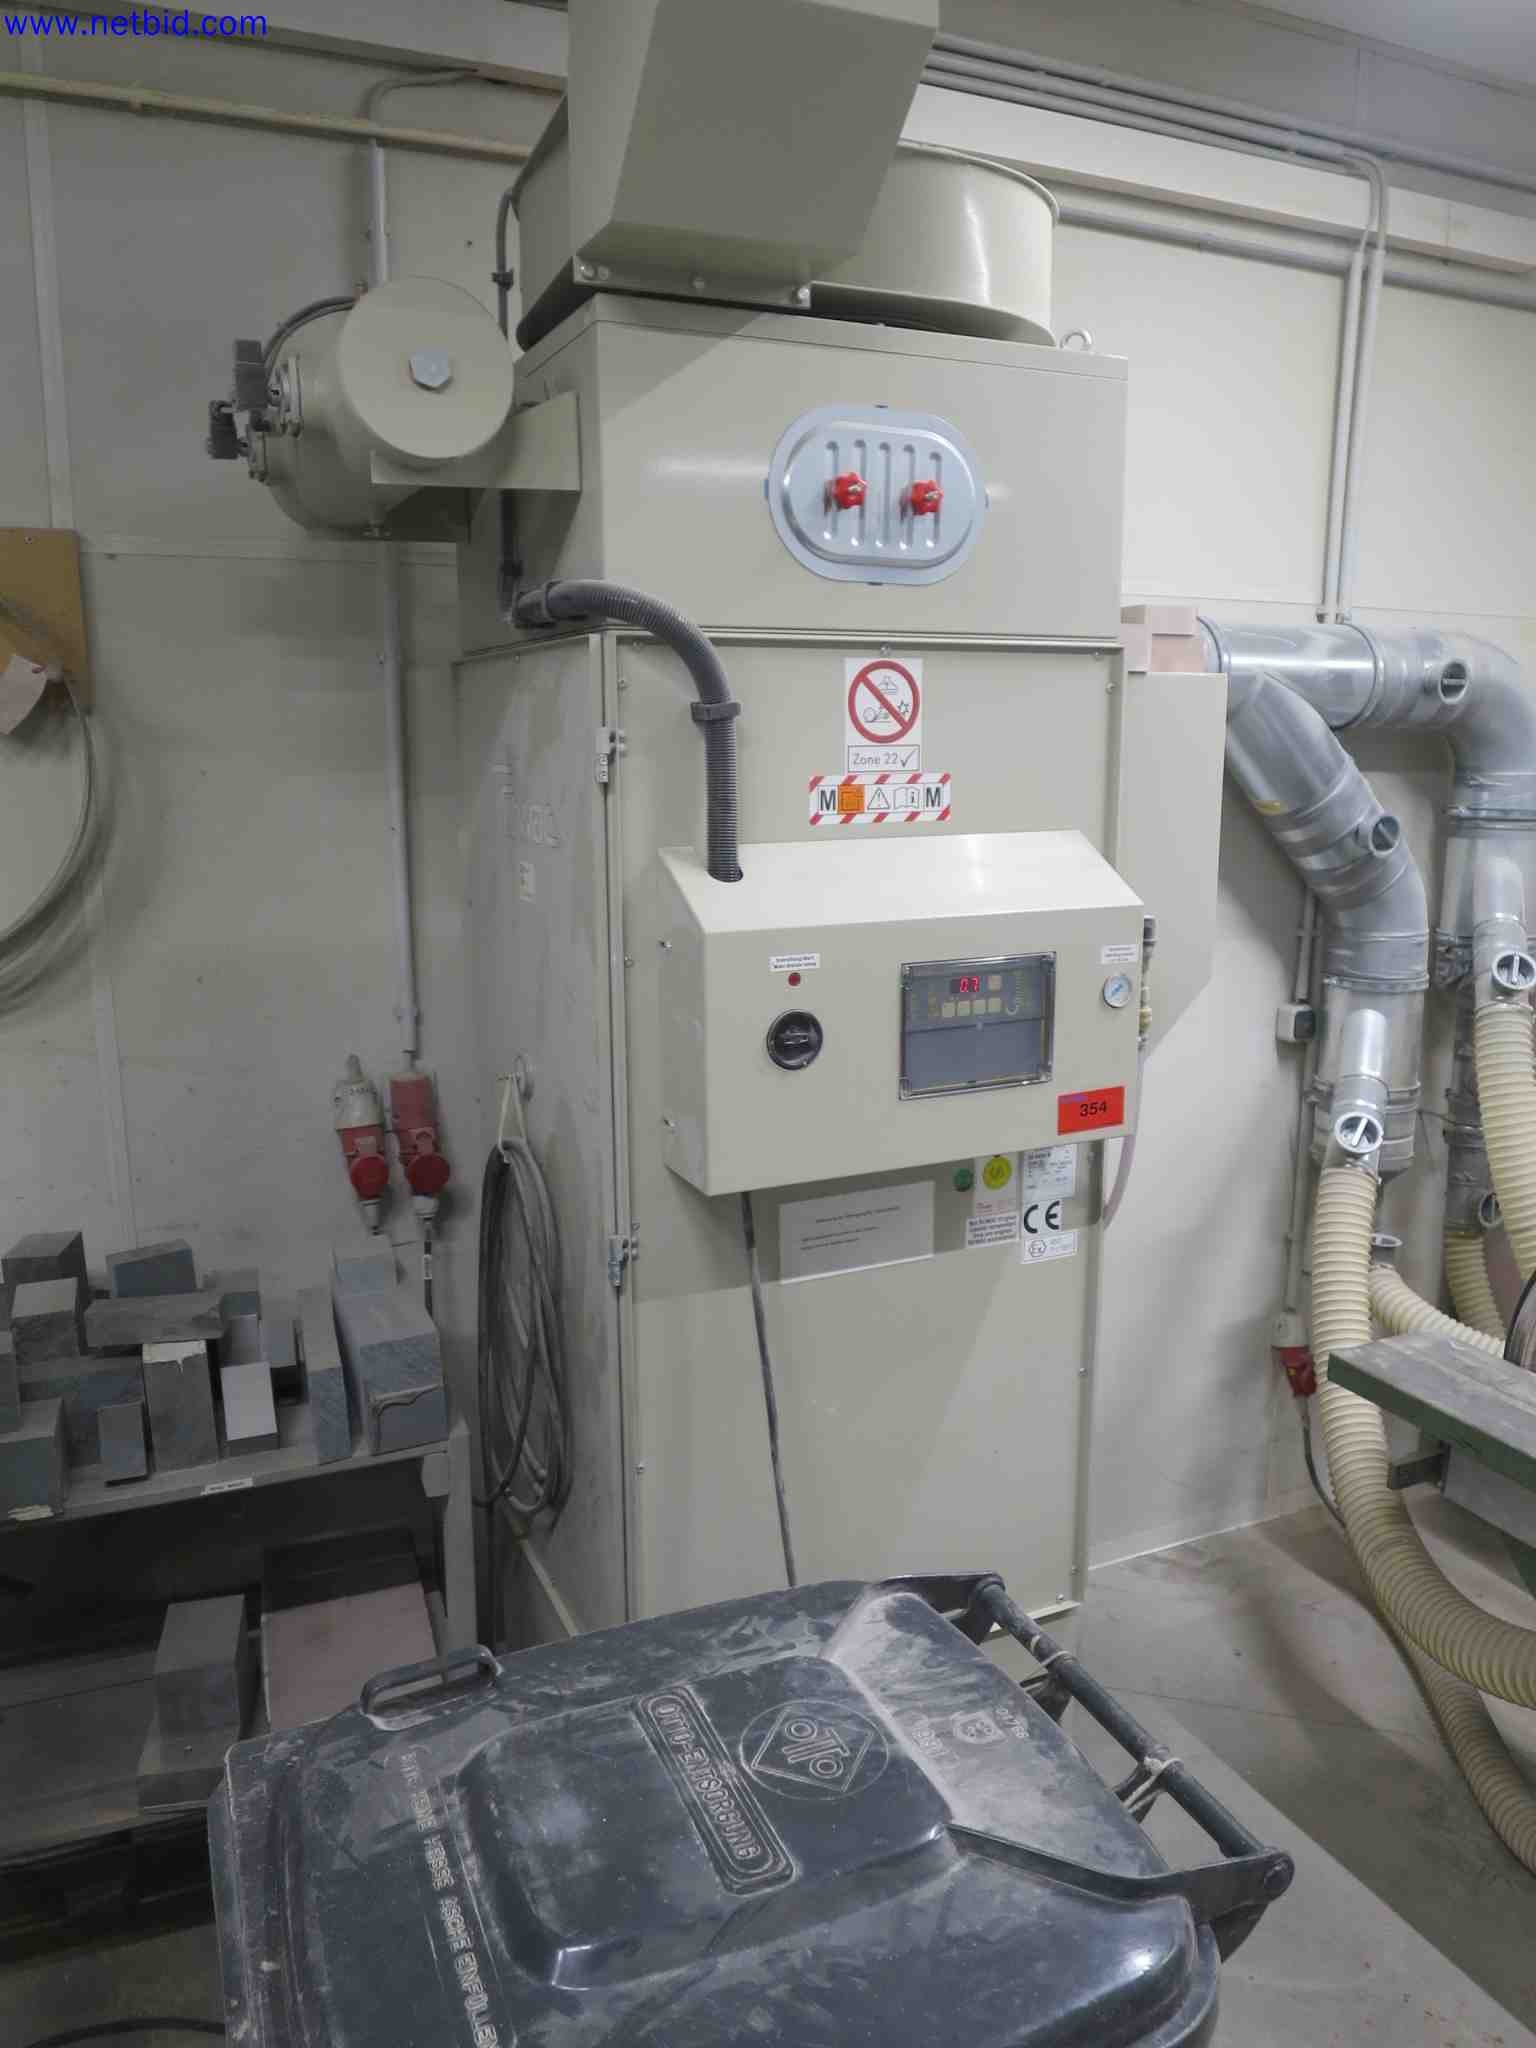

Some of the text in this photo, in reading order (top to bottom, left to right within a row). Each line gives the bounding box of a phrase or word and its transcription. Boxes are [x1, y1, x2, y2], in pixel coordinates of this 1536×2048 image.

[853, 752, 898, 765] Zone 22
[820, 790, 836, 811] M
[925, 787, 941, 807] M
[1080, 1101, 1107, 1117] 354
[1024, 1200, 1060, 1234] CE
[783, 1717, 850, 1779] OTTO
[656, 1703, 761, 1860] OTTO-ENTSORGUNG
